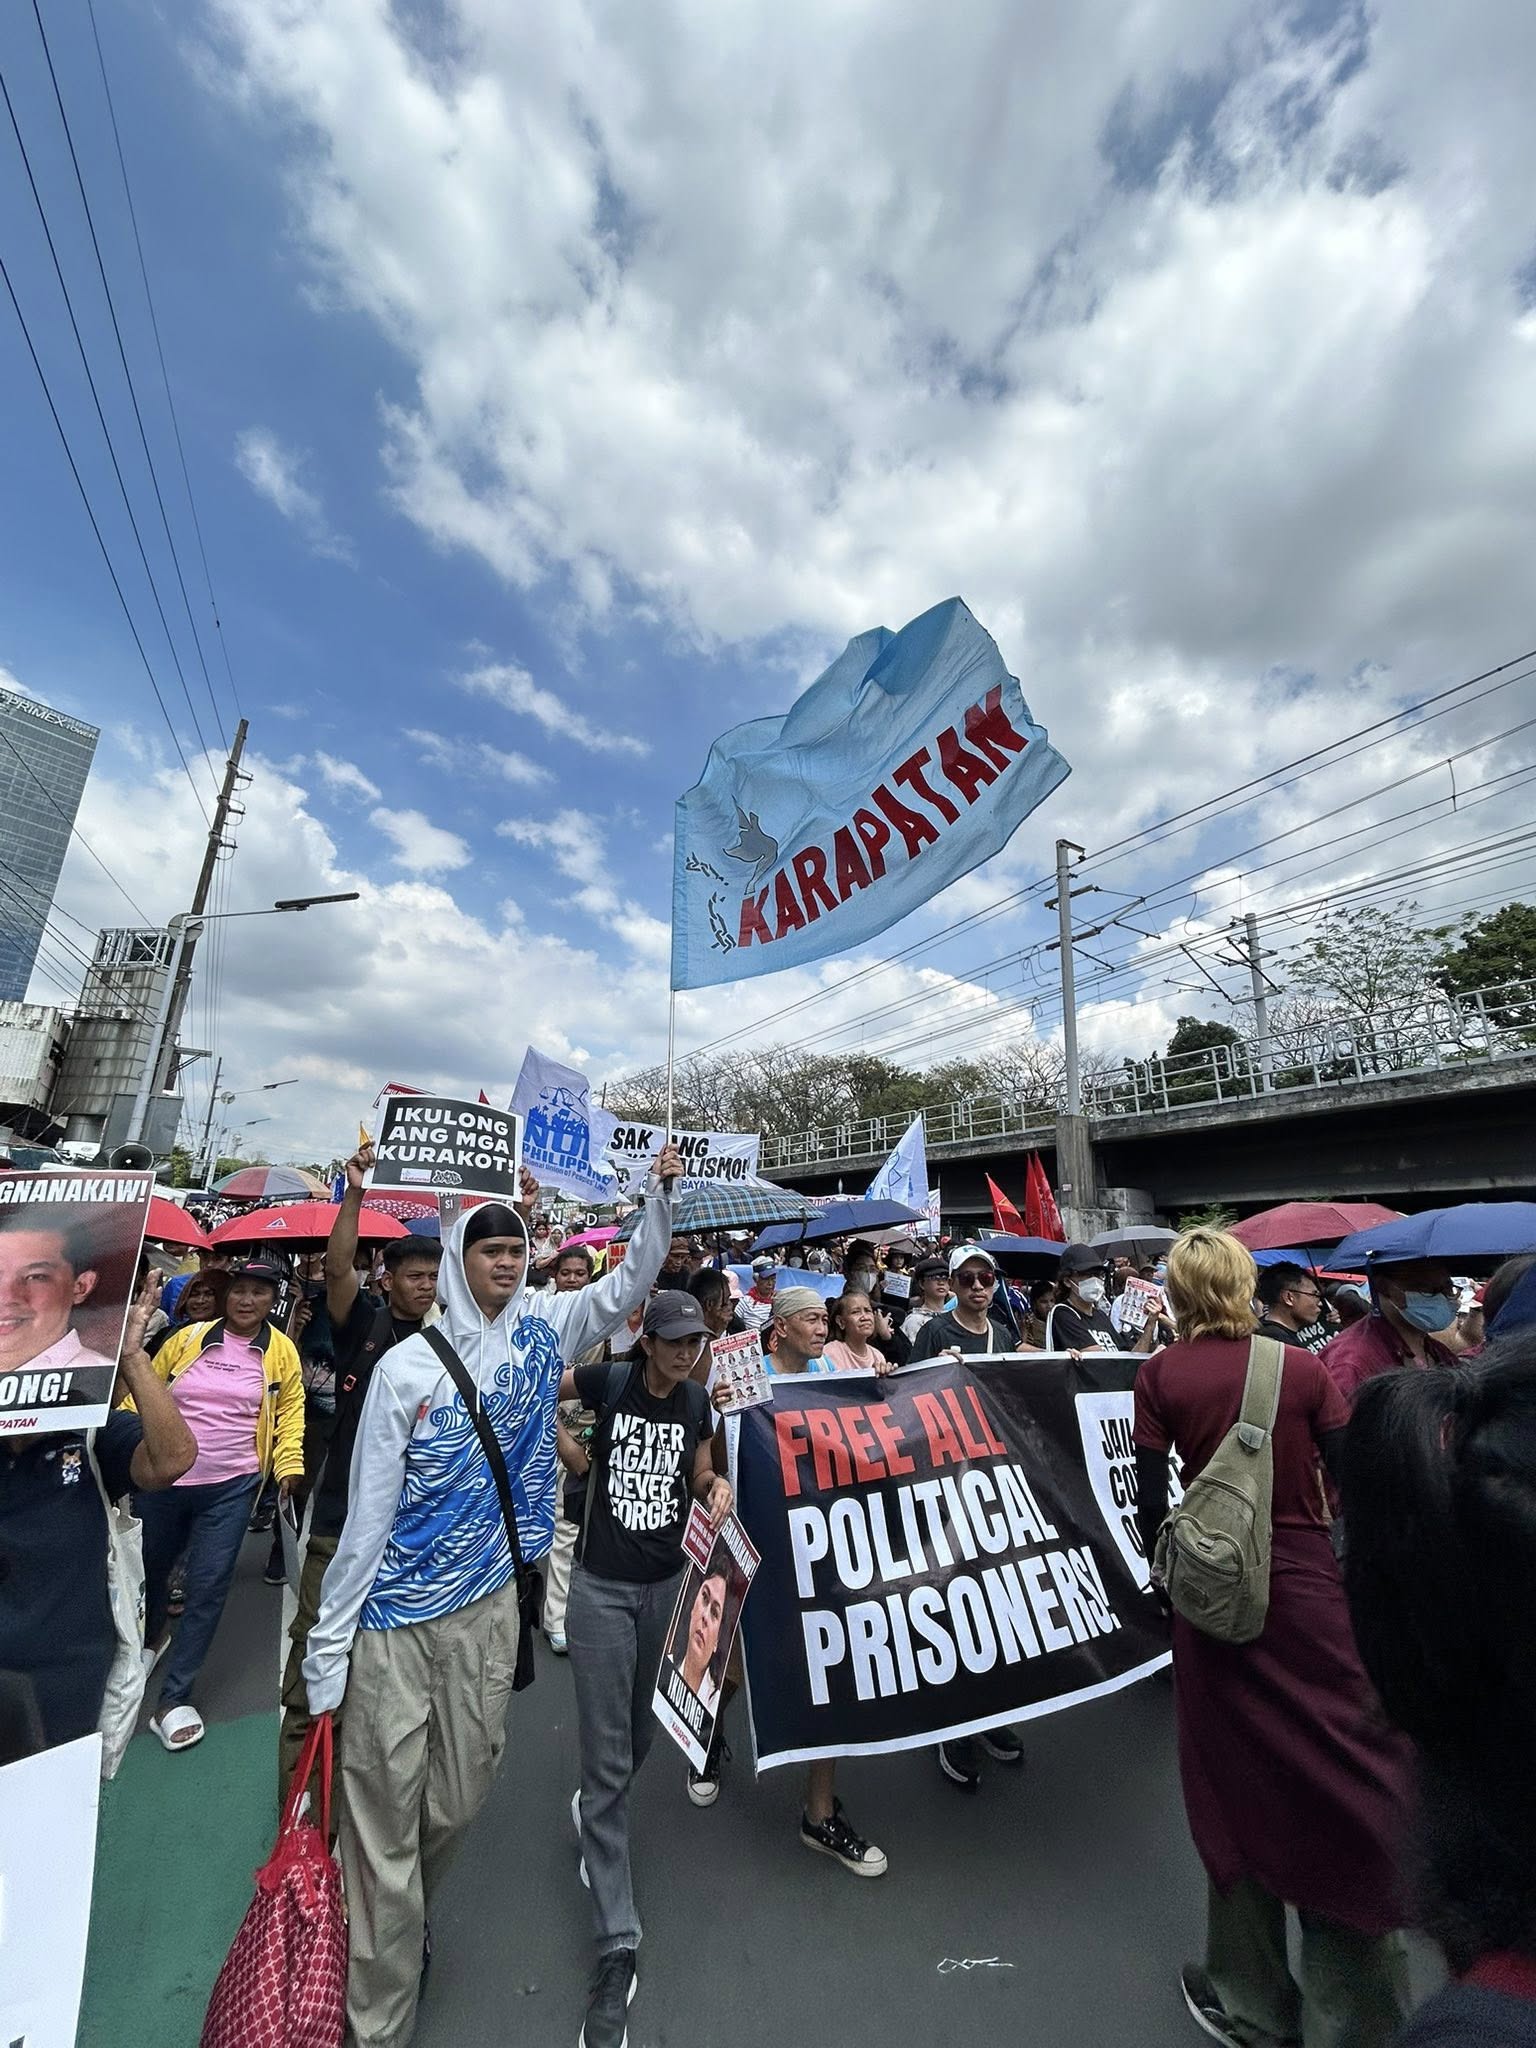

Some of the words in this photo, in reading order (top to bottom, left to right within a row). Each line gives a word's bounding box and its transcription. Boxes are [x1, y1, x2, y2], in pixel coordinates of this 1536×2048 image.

[7, 697, 67, 728] PRIMEX
[66, 724, 98, 740] TOWER
[737, 684, 1029, 947] KARAPATAN
[395, 1107, 509, 1136] IKULONG
[611, 1128, 653, 1150] SAK
[388, 1126, 449, 1144] ANG
[456, 1131, 510, 1155] MGA
[378, 1145, 514, 1174] KURAKOT!
[546, 1163, 563, 1175] Union
[611, 1413, 685, 1451] NEVER
[774, 1402, 916, 1497] FREE
[911, 1385, 1007, 1468] ALL
[608, 1468, 675, 1501] NEVER
[787, 1464, 1059, 1599] POLITICAL
[801, 1546, 1122, 1706] PRISONERS!
